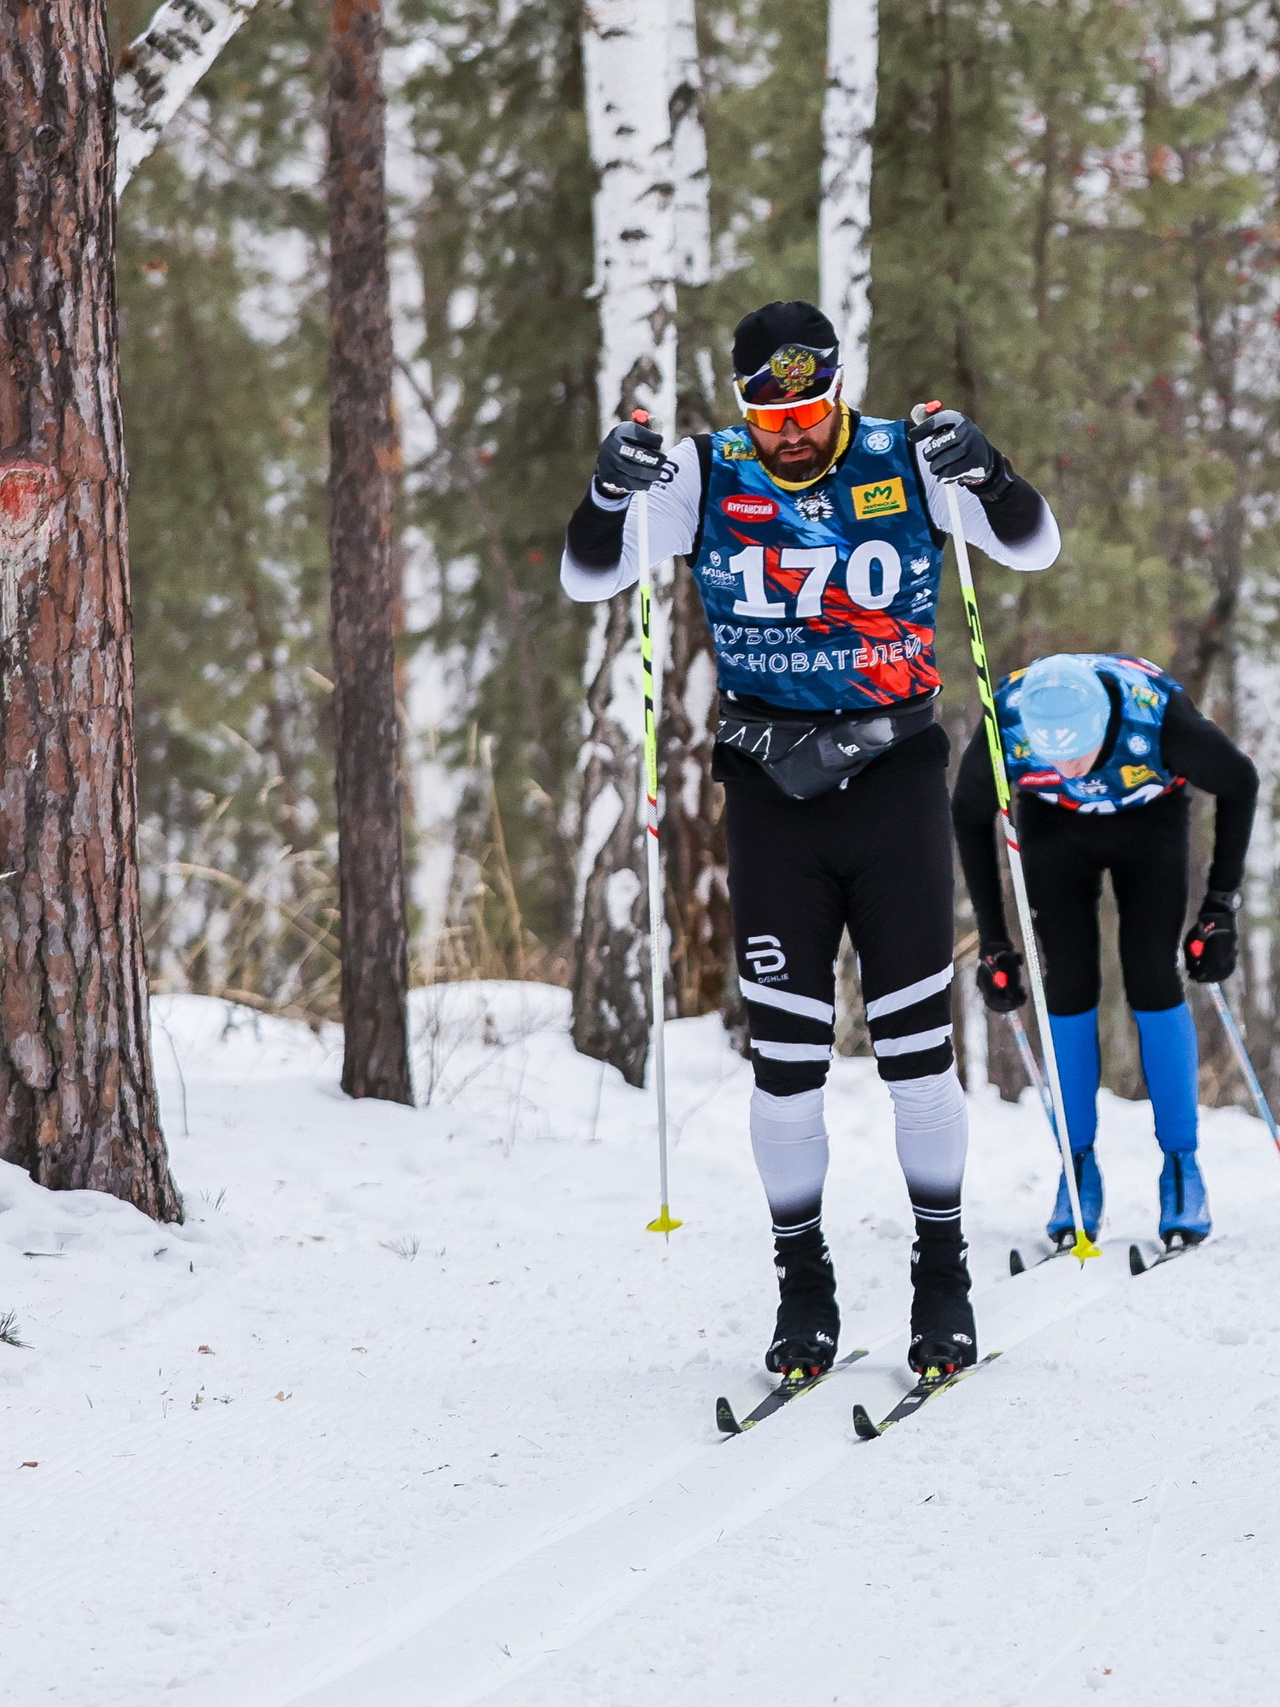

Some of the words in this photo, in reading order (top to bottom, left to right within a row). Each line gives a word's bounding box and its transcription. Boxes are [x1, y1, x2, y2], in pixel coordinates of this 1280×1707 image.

[727, 502, 773, 515] КУРГАНСКИЙ
[729, 540, 902, 619] 170
[713, 623, 806, 645] КУБОК
